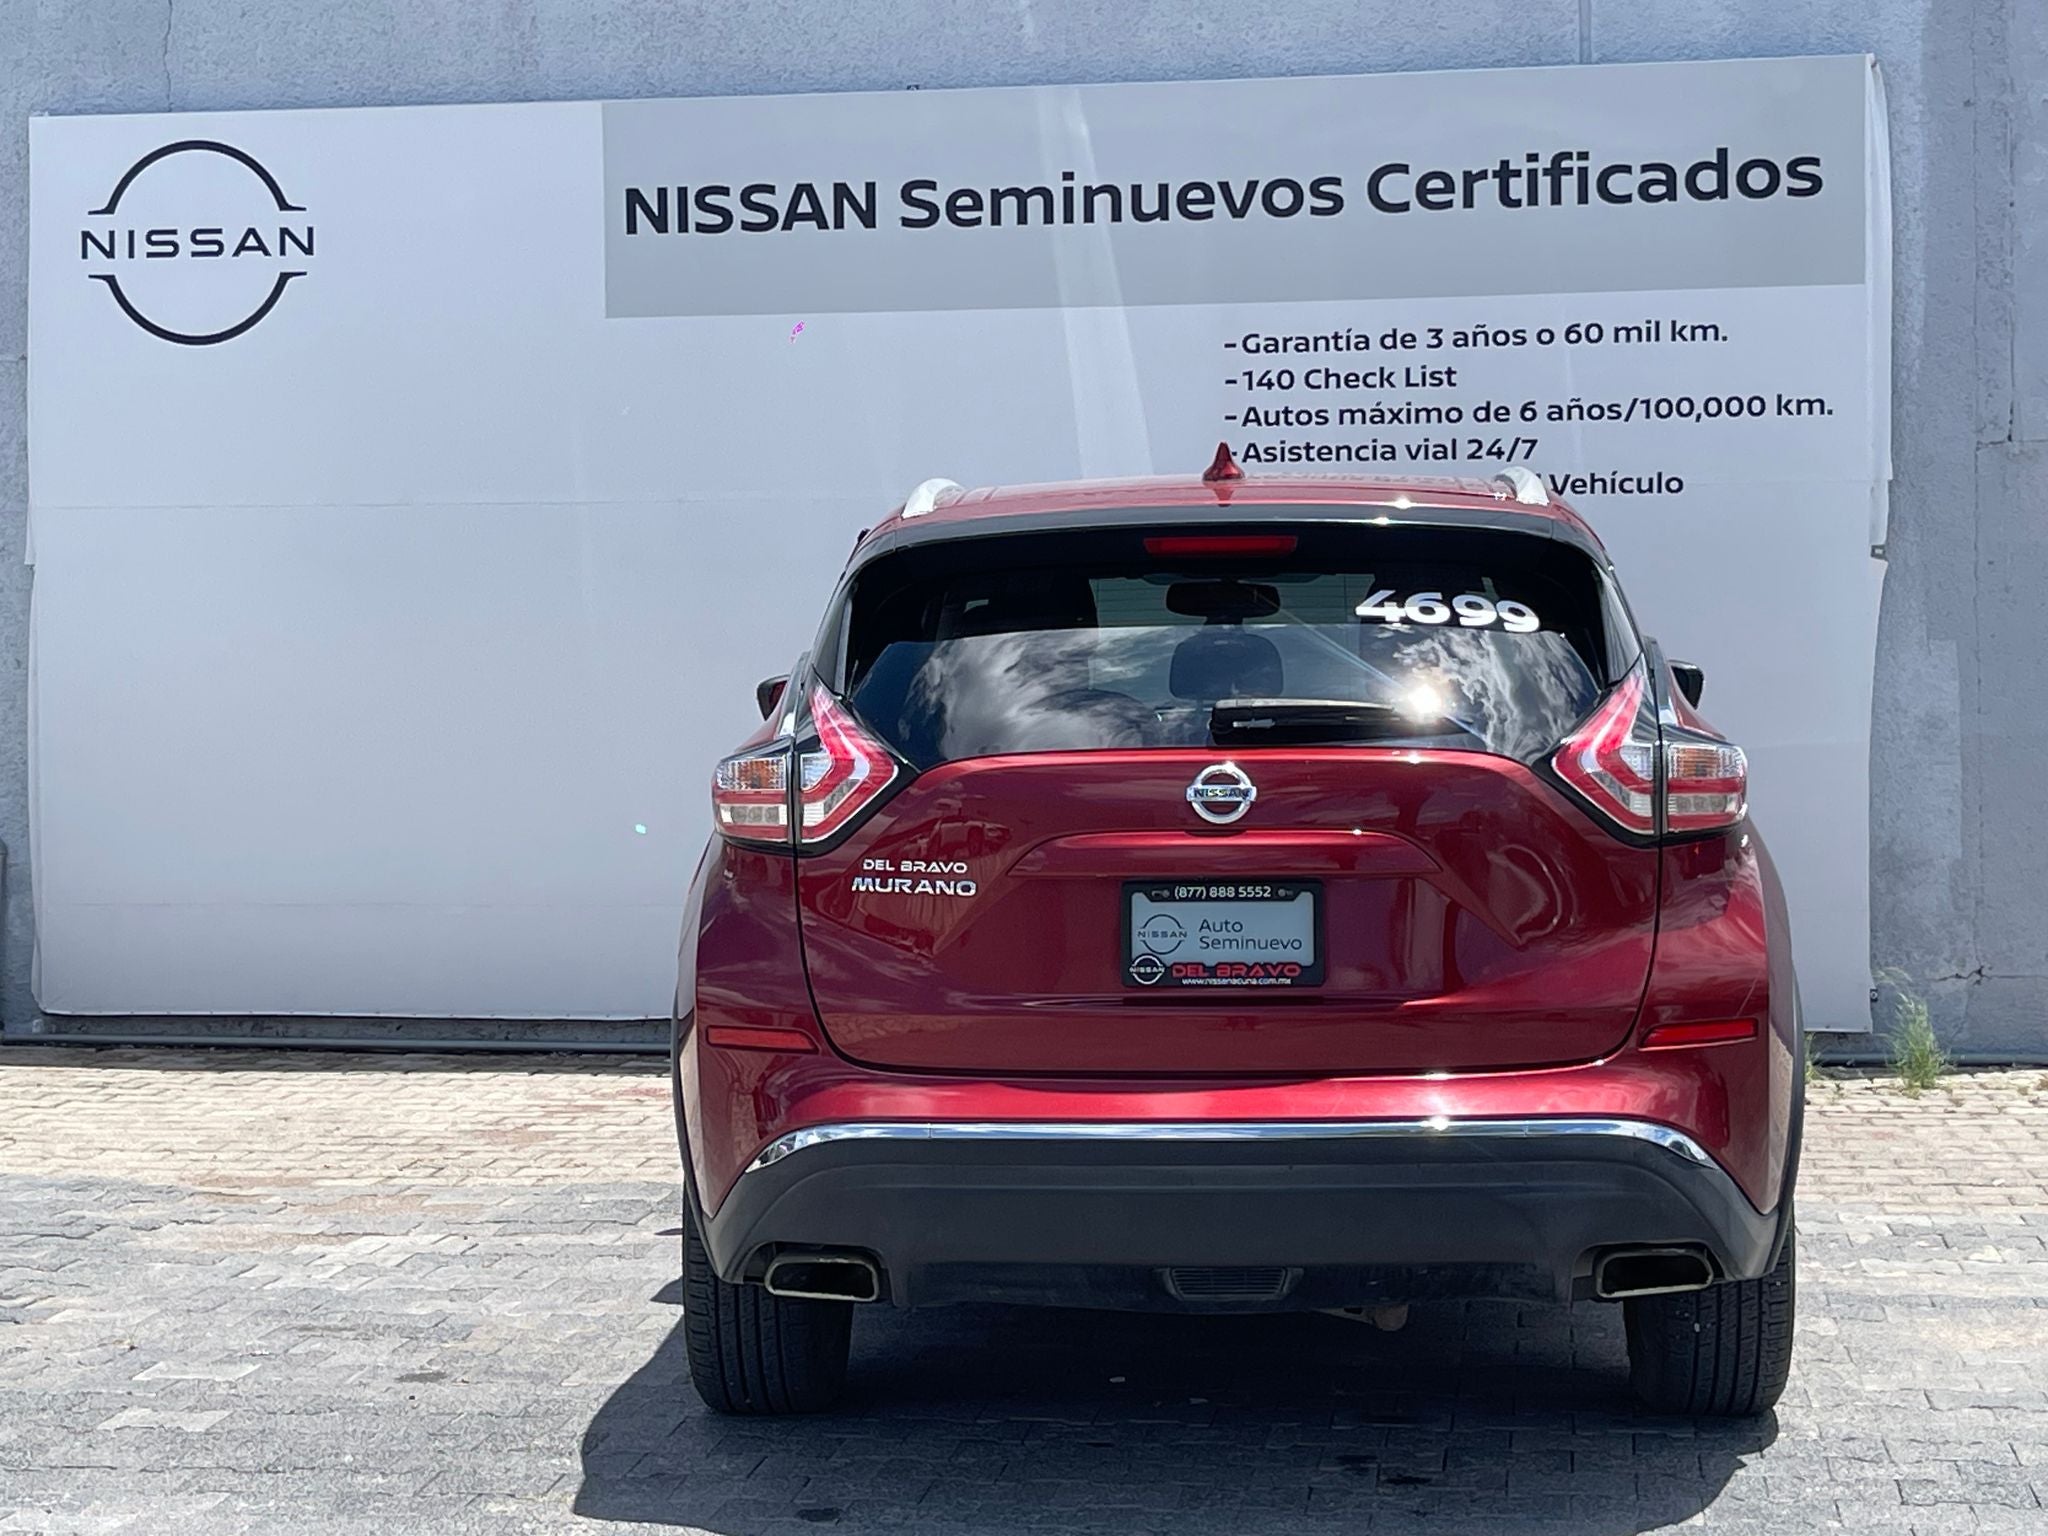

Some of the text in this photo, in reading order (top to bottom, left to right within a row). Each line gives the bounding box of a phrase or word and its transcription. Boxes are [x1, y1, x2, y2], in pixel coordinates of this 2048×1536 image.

[626, 147, 1823, 235] NISSAN Seminuevos Certificados
[81, 226, 315, 260] NISSAN
[1379, 328, 1417, 350] de
[1426, 328, 1444, 349] 3
[1452, 323, 1528, 348] años
[1536, 328, 1555, 346] o
[1564, 323, 1604, 345] 60
[1613, 319, 1661, 344] mil
[1670, 320, 1728, 342] km.
[1304, 366, 1396, 390] Check
[1405, 364, 1457, 388] List
[1338, 401, 1463, 426] máximo
[1472, 400, 1511, 423] de
[1519, 400, 1538, 422] 6
[1546, 395, 1766, 423] años/100,000
[1776, 393, 1833, 416] km.
[1404, 437, 1457, 461] vial
[1466, 436, 1538, 463] 24/7
[1549, 471, 1684, 495] Vehículo
[1354, 589, 1541, 634] 4699
[1193, 787, 1253, 801] NISSAN
[862, 858, 968, 874] DEL BRAVO
[851, 876, 977, 897] MURANO
[1174, 886, 1272, 899] (877) 888 5552
[1137, 930, 1187, 938] NISSAN
[1199, 918, 1243, 933] Auto
[1199, 936, 1303, 951] Seminuevo
[1172, 964, 1301, 977] DEL BRAVO
